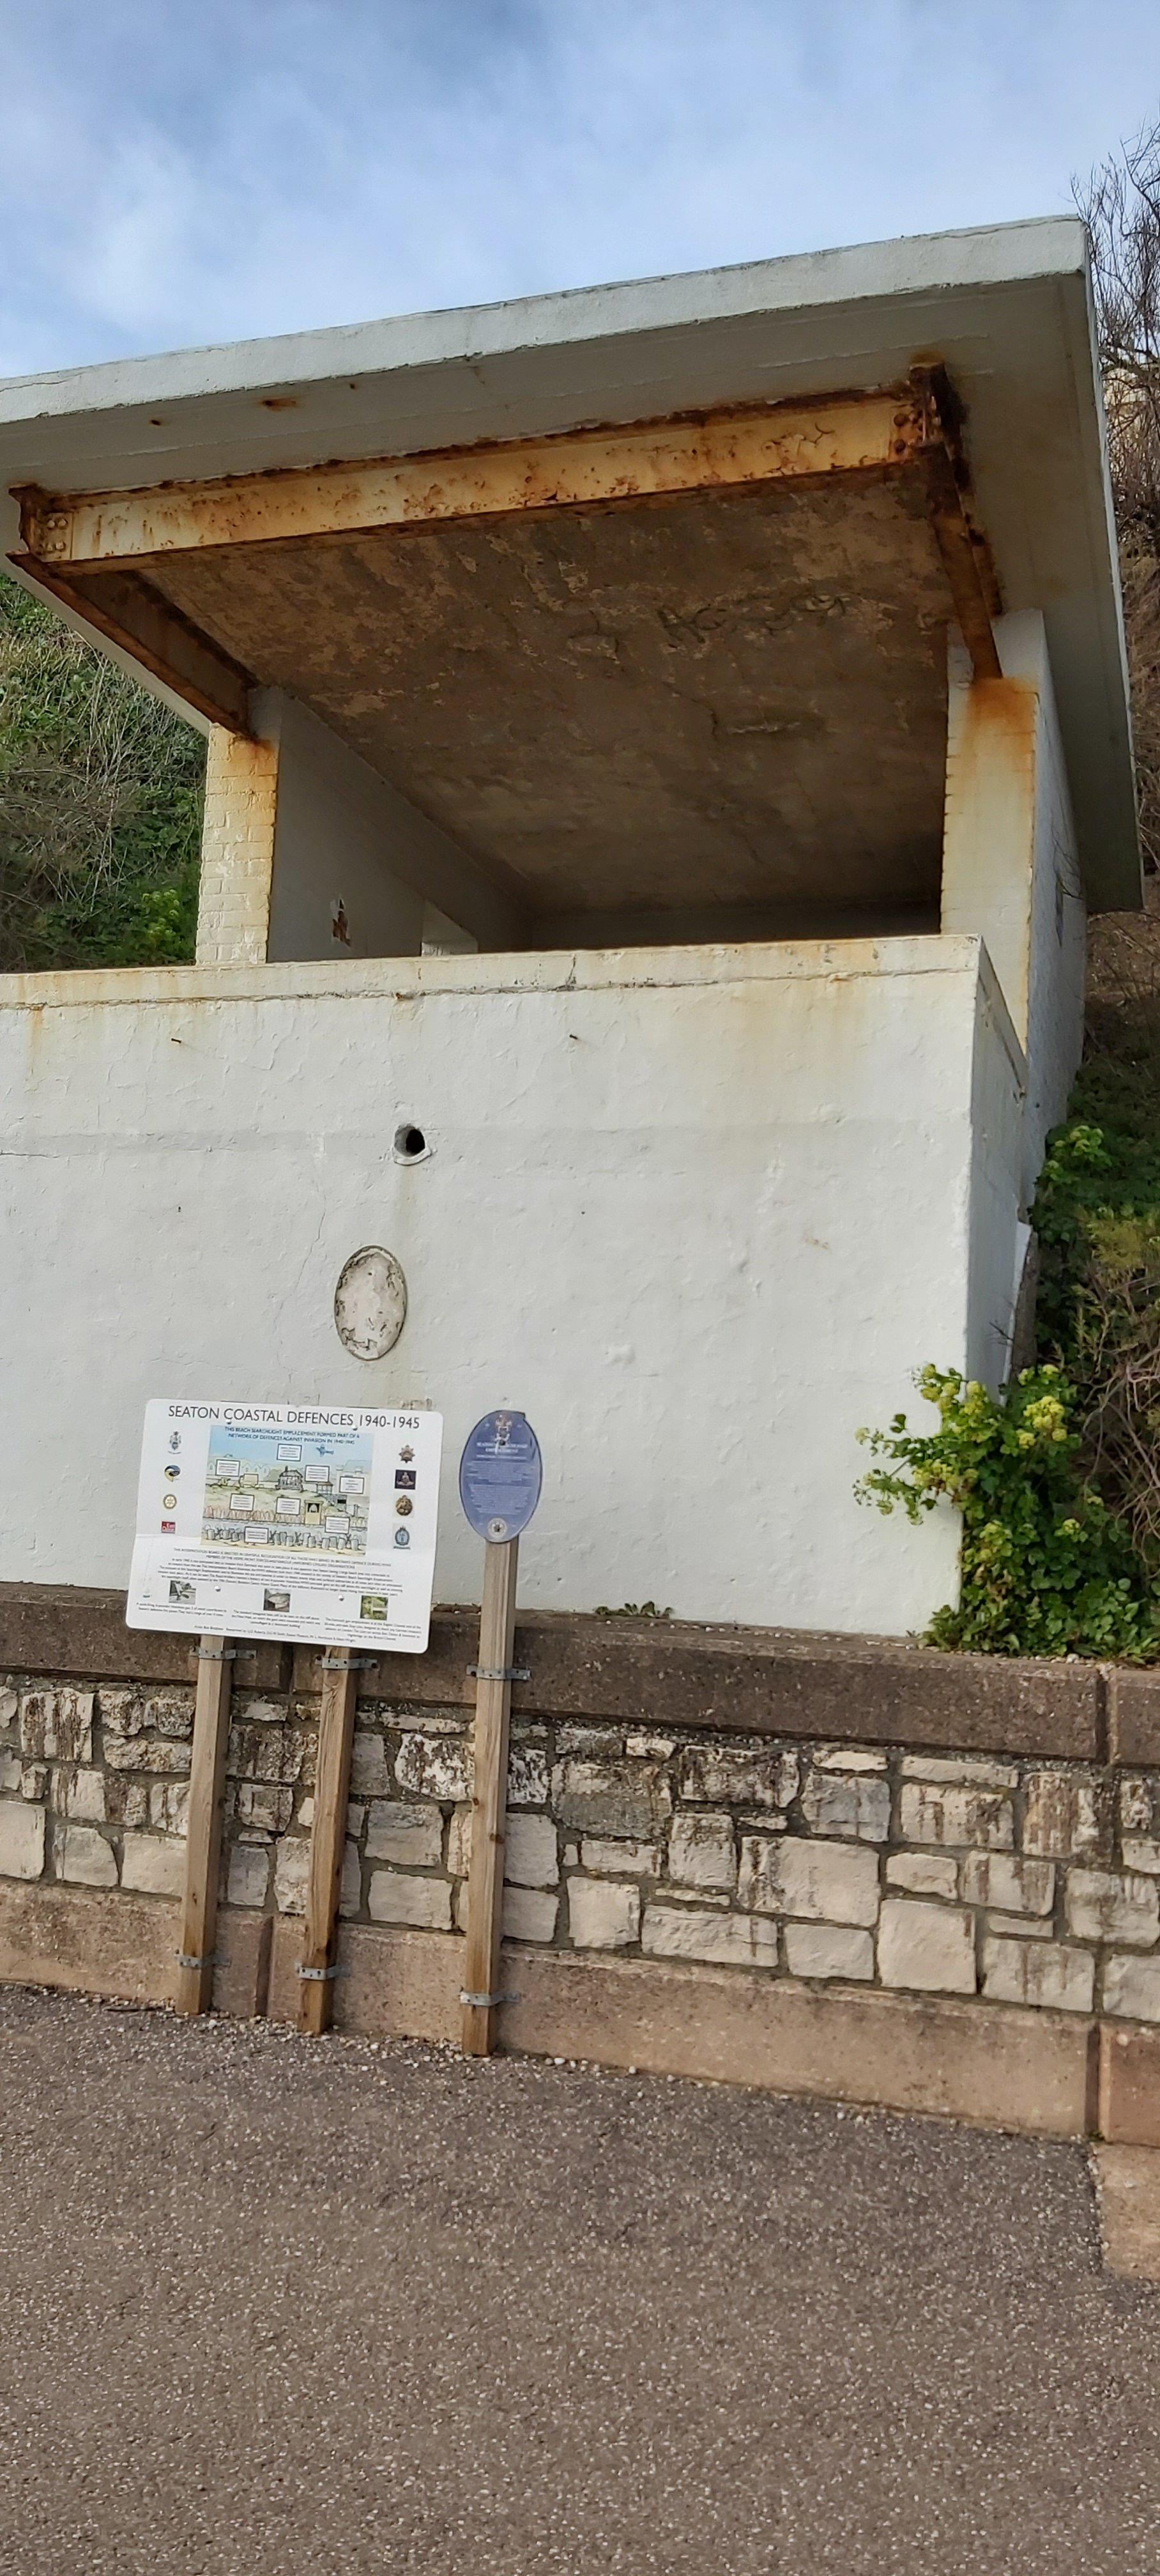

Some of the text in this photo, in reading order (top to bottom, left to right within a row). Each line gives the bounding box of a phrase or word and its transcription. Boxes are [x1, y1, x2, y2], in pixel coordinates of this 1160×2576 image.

[168, 1406, 419, 1429] SEATON COASTAL DEFENCES 1940-1945
